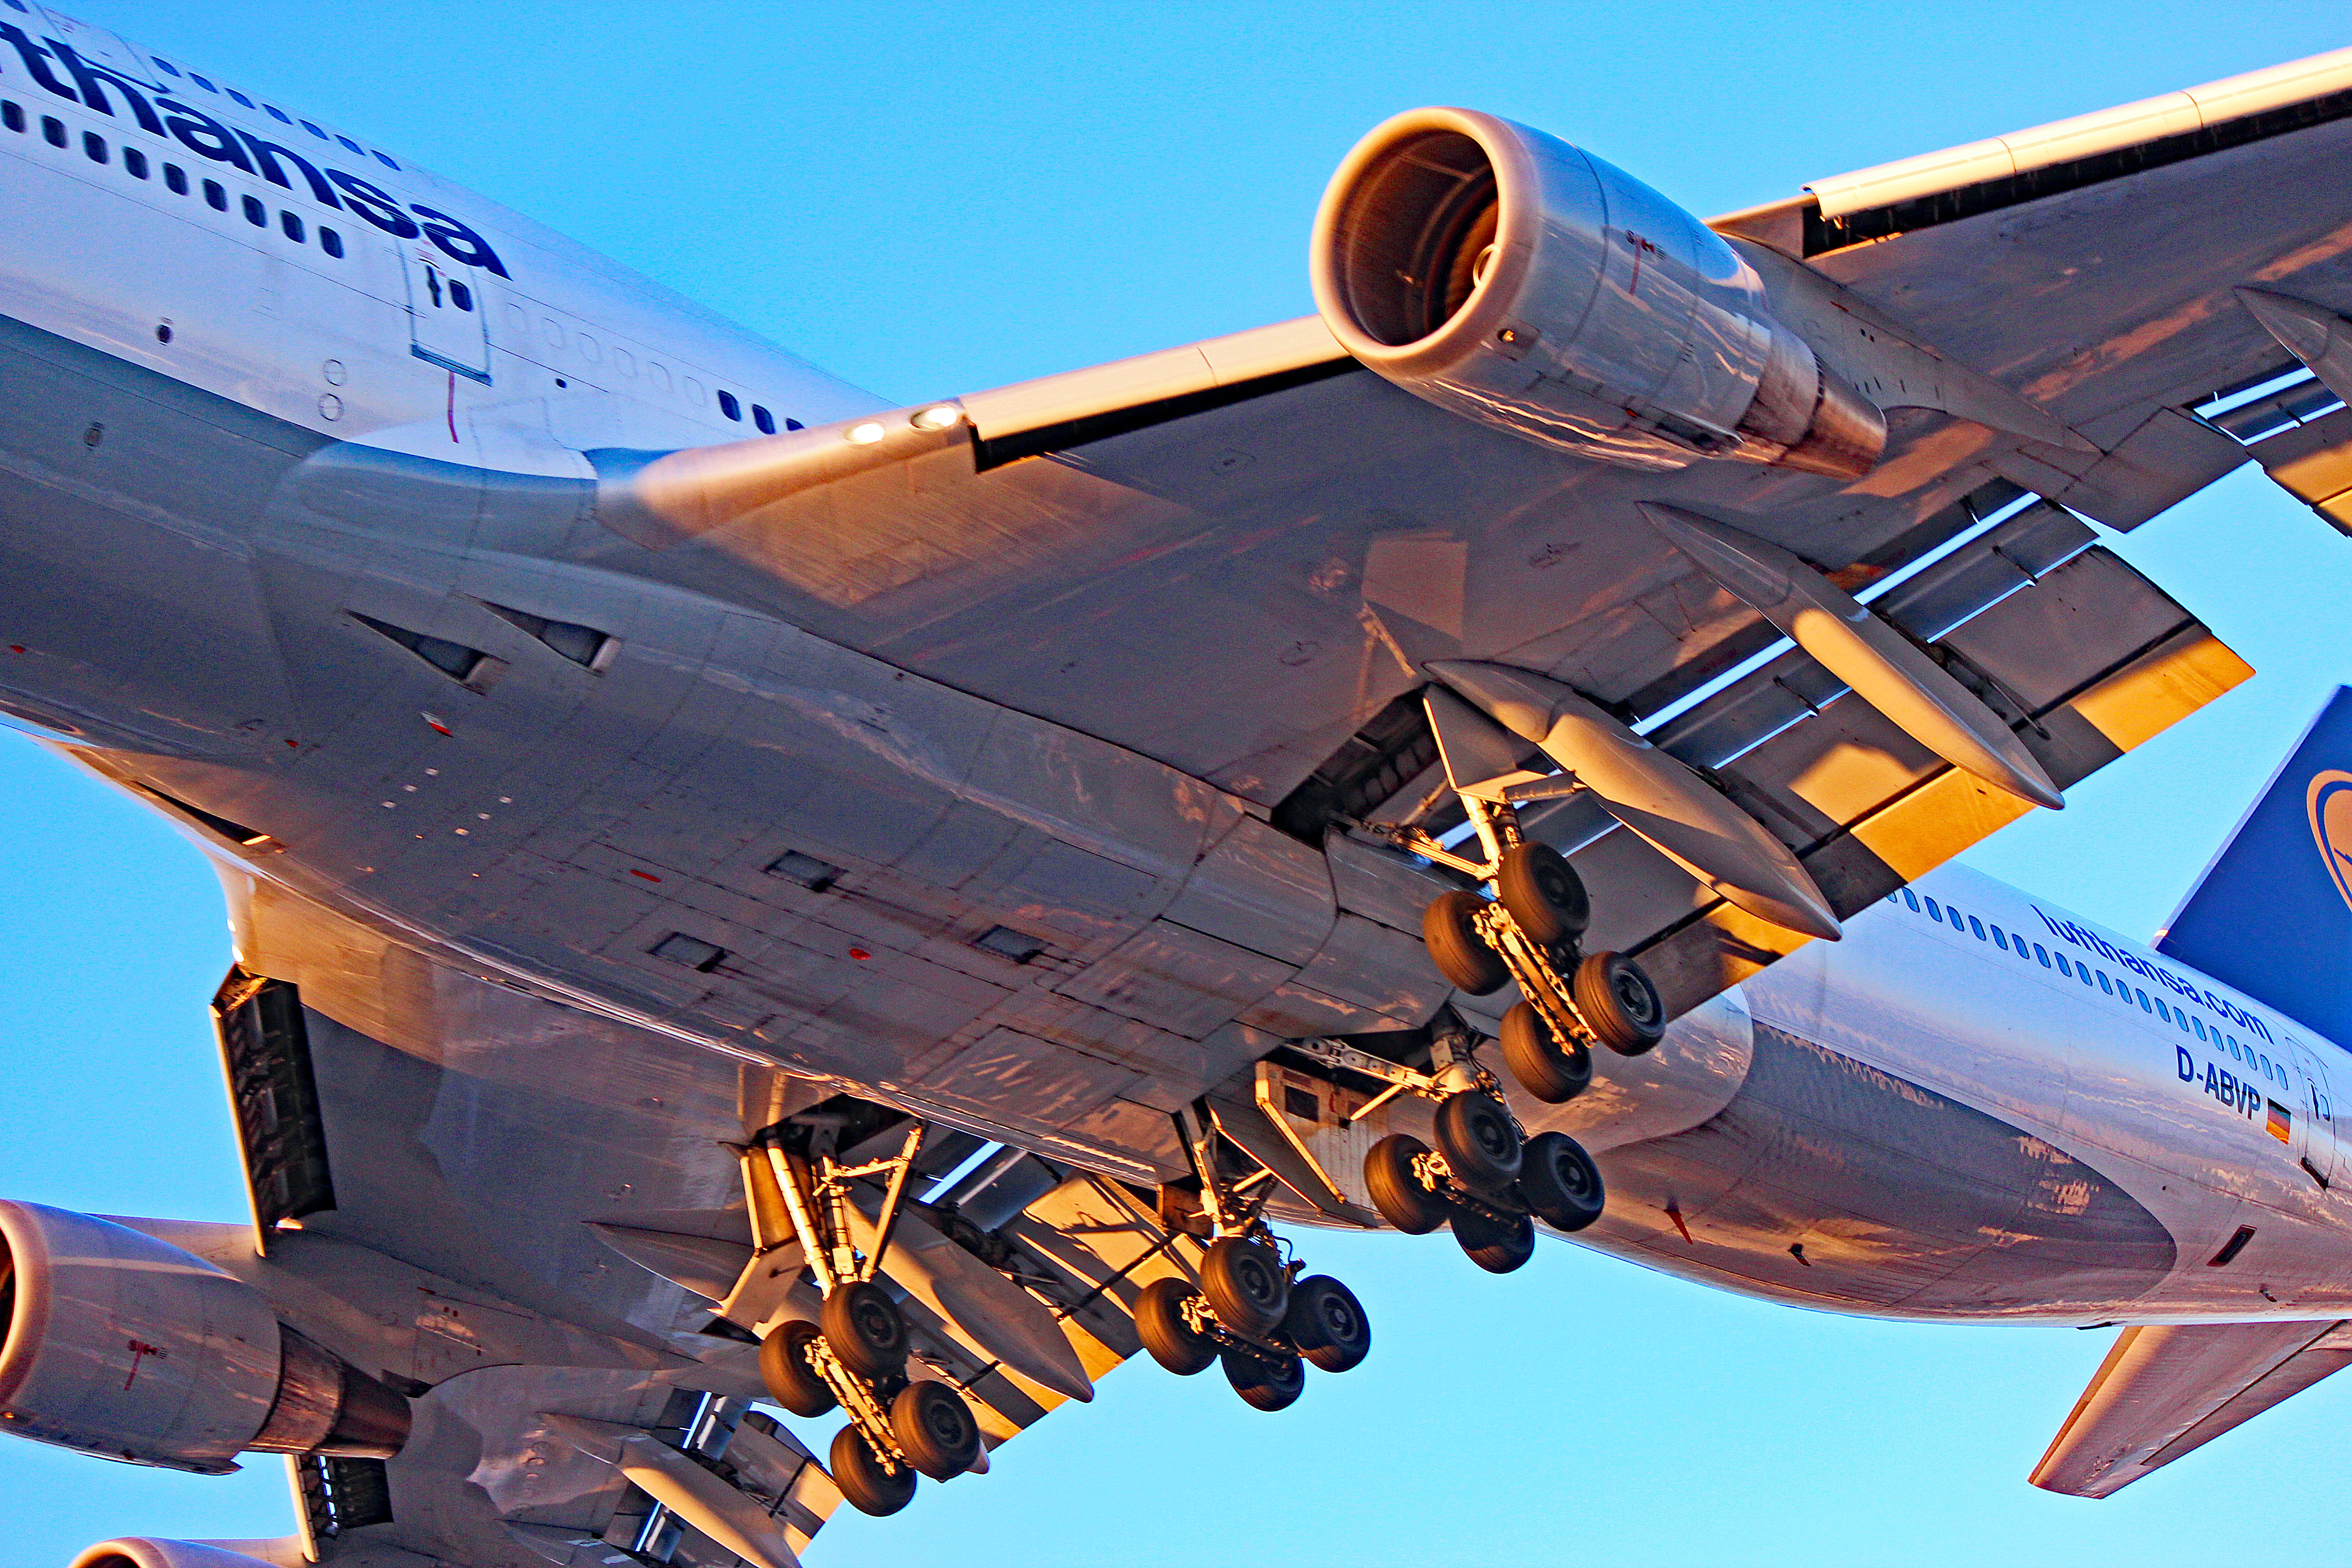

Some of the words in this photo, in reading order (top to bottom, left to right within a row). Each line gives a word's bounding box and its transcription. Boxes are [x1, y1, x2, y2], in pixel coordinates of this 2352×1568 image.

[0, 20, 514, 281] thansa
[2030, 903, 2274, 1045] lufthansa.com
[2175, 1044, 2261, 1120] D-ABVP
